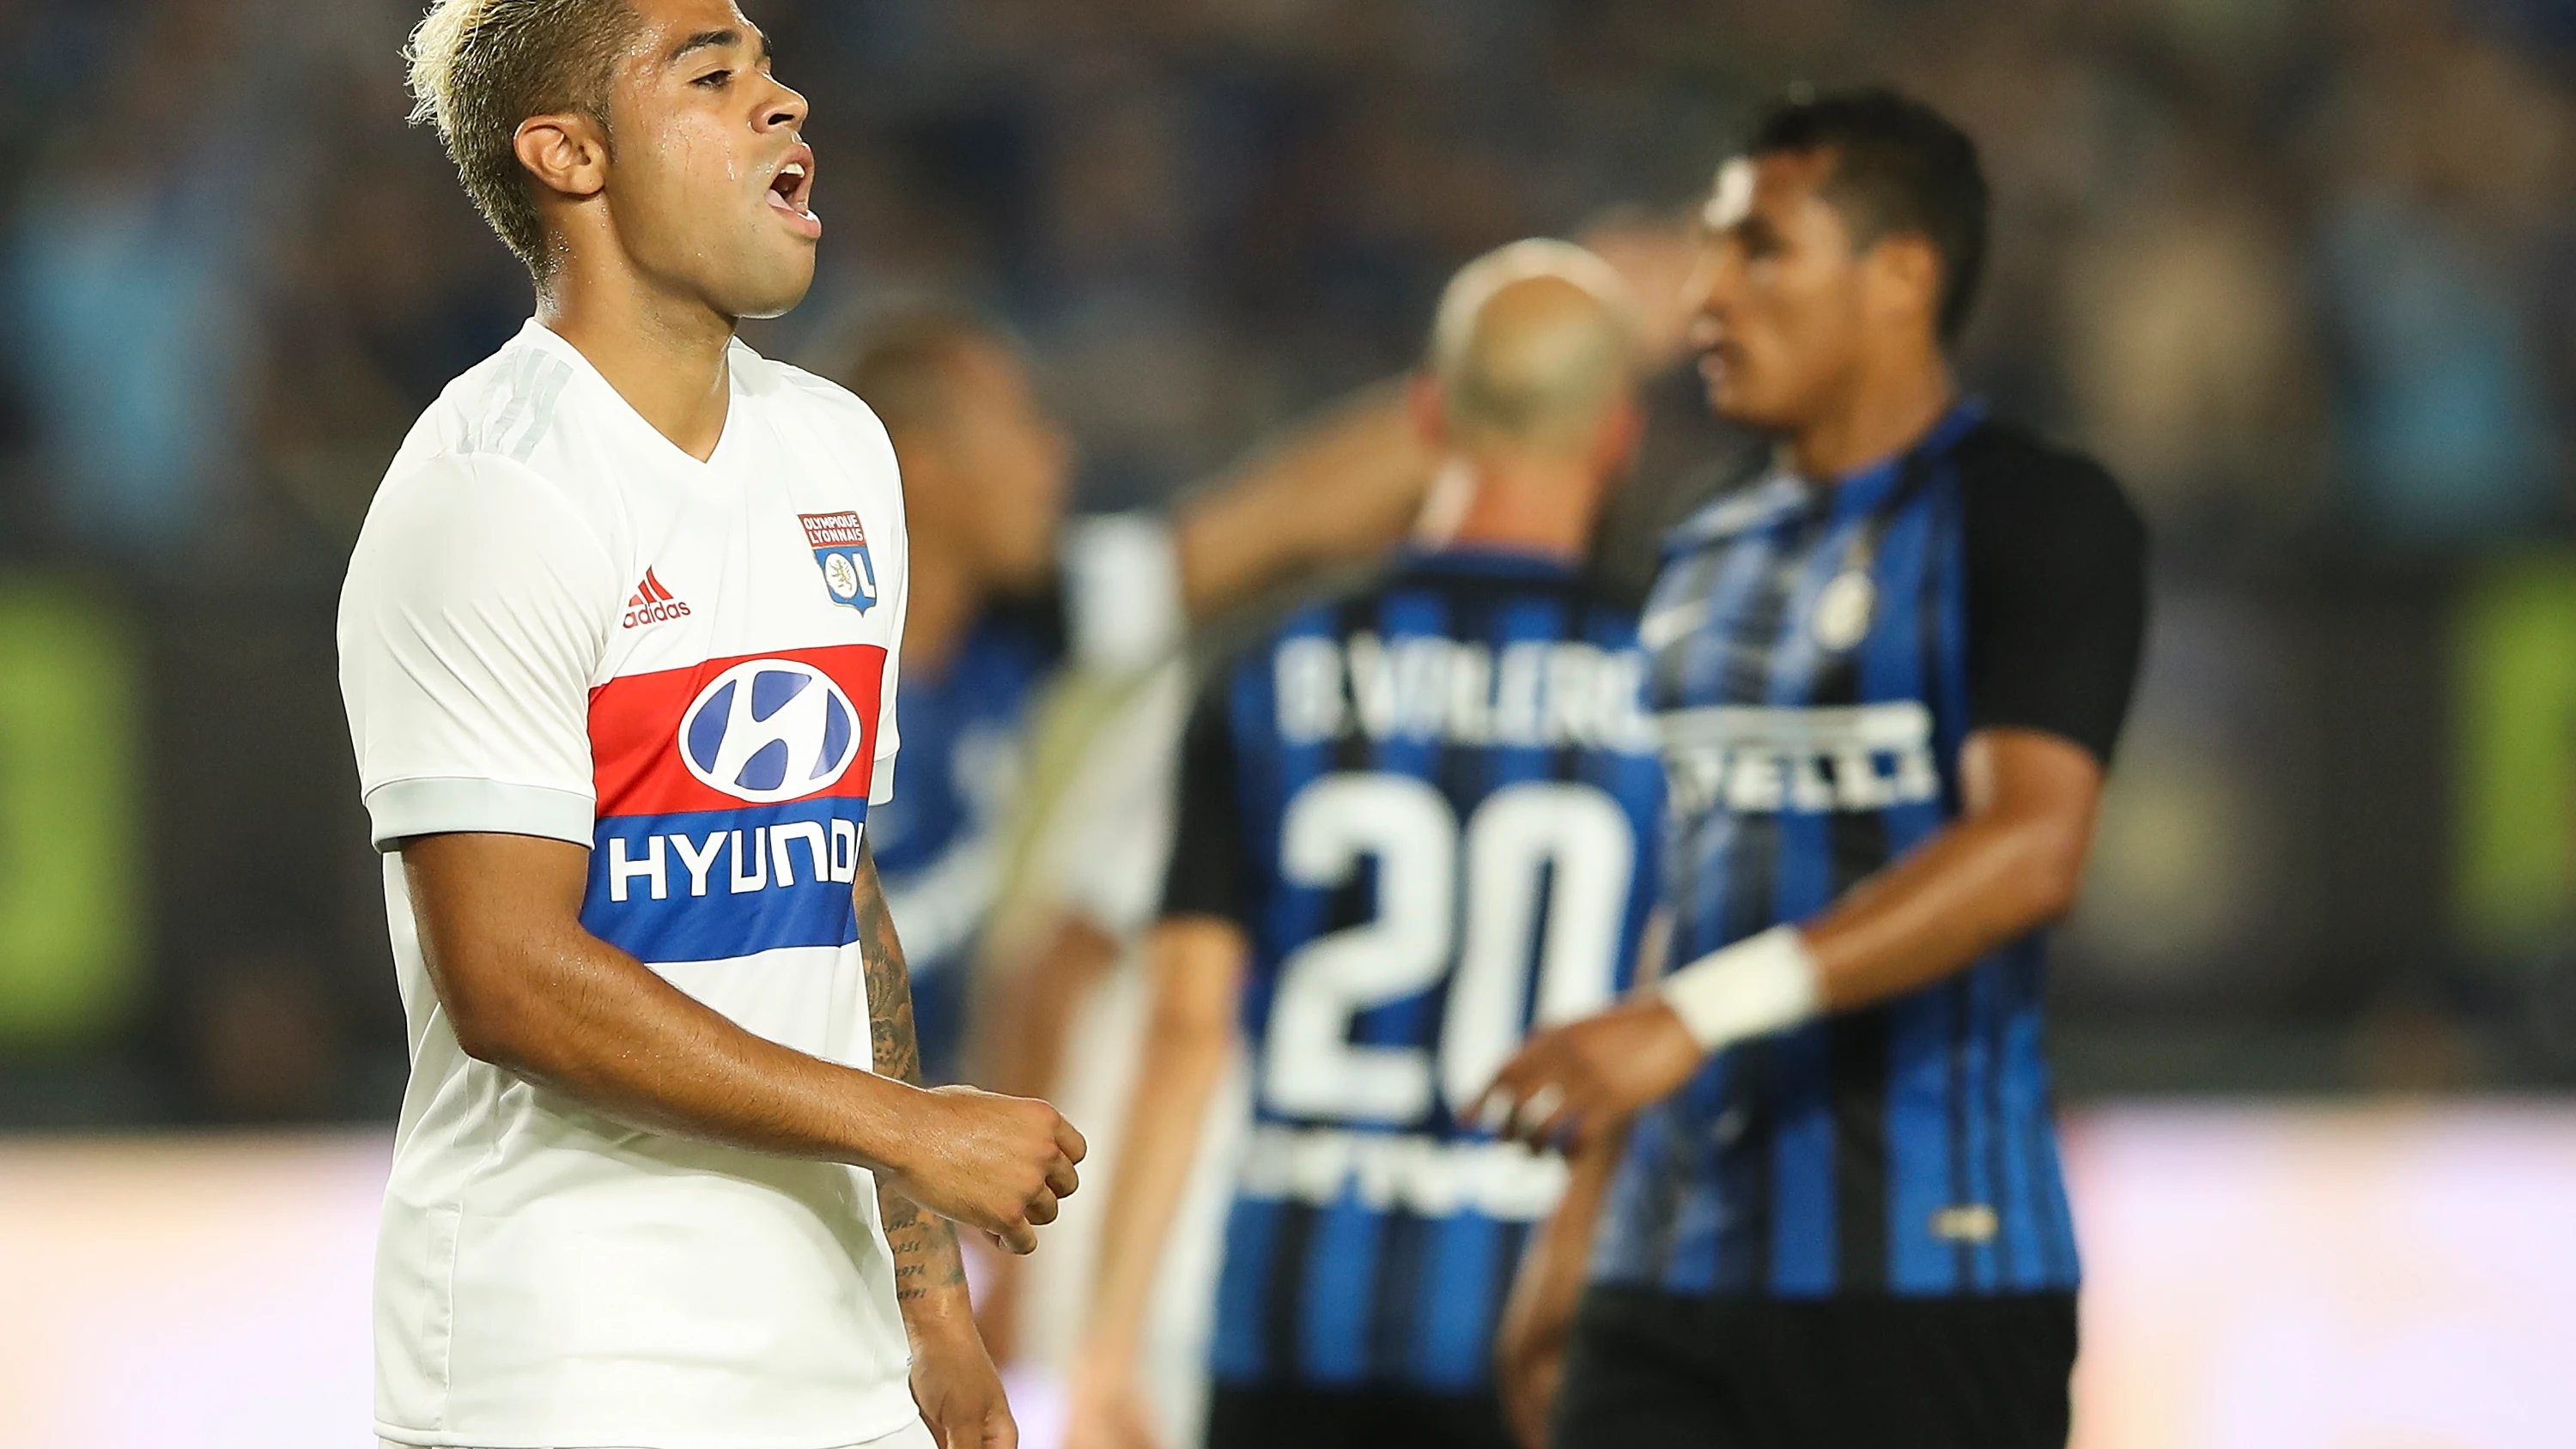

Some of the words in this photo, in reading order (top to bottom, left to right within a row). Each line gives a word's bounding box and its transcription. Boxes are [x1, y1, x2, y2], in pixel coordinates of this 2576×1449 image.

[803, 514, 860, 530] OLYMPIQUE
[808, 528, 864, 544] LYONNAIS
[623, 601, 691, 628] adidas
[1263, 773, 1636, 1123] 20
